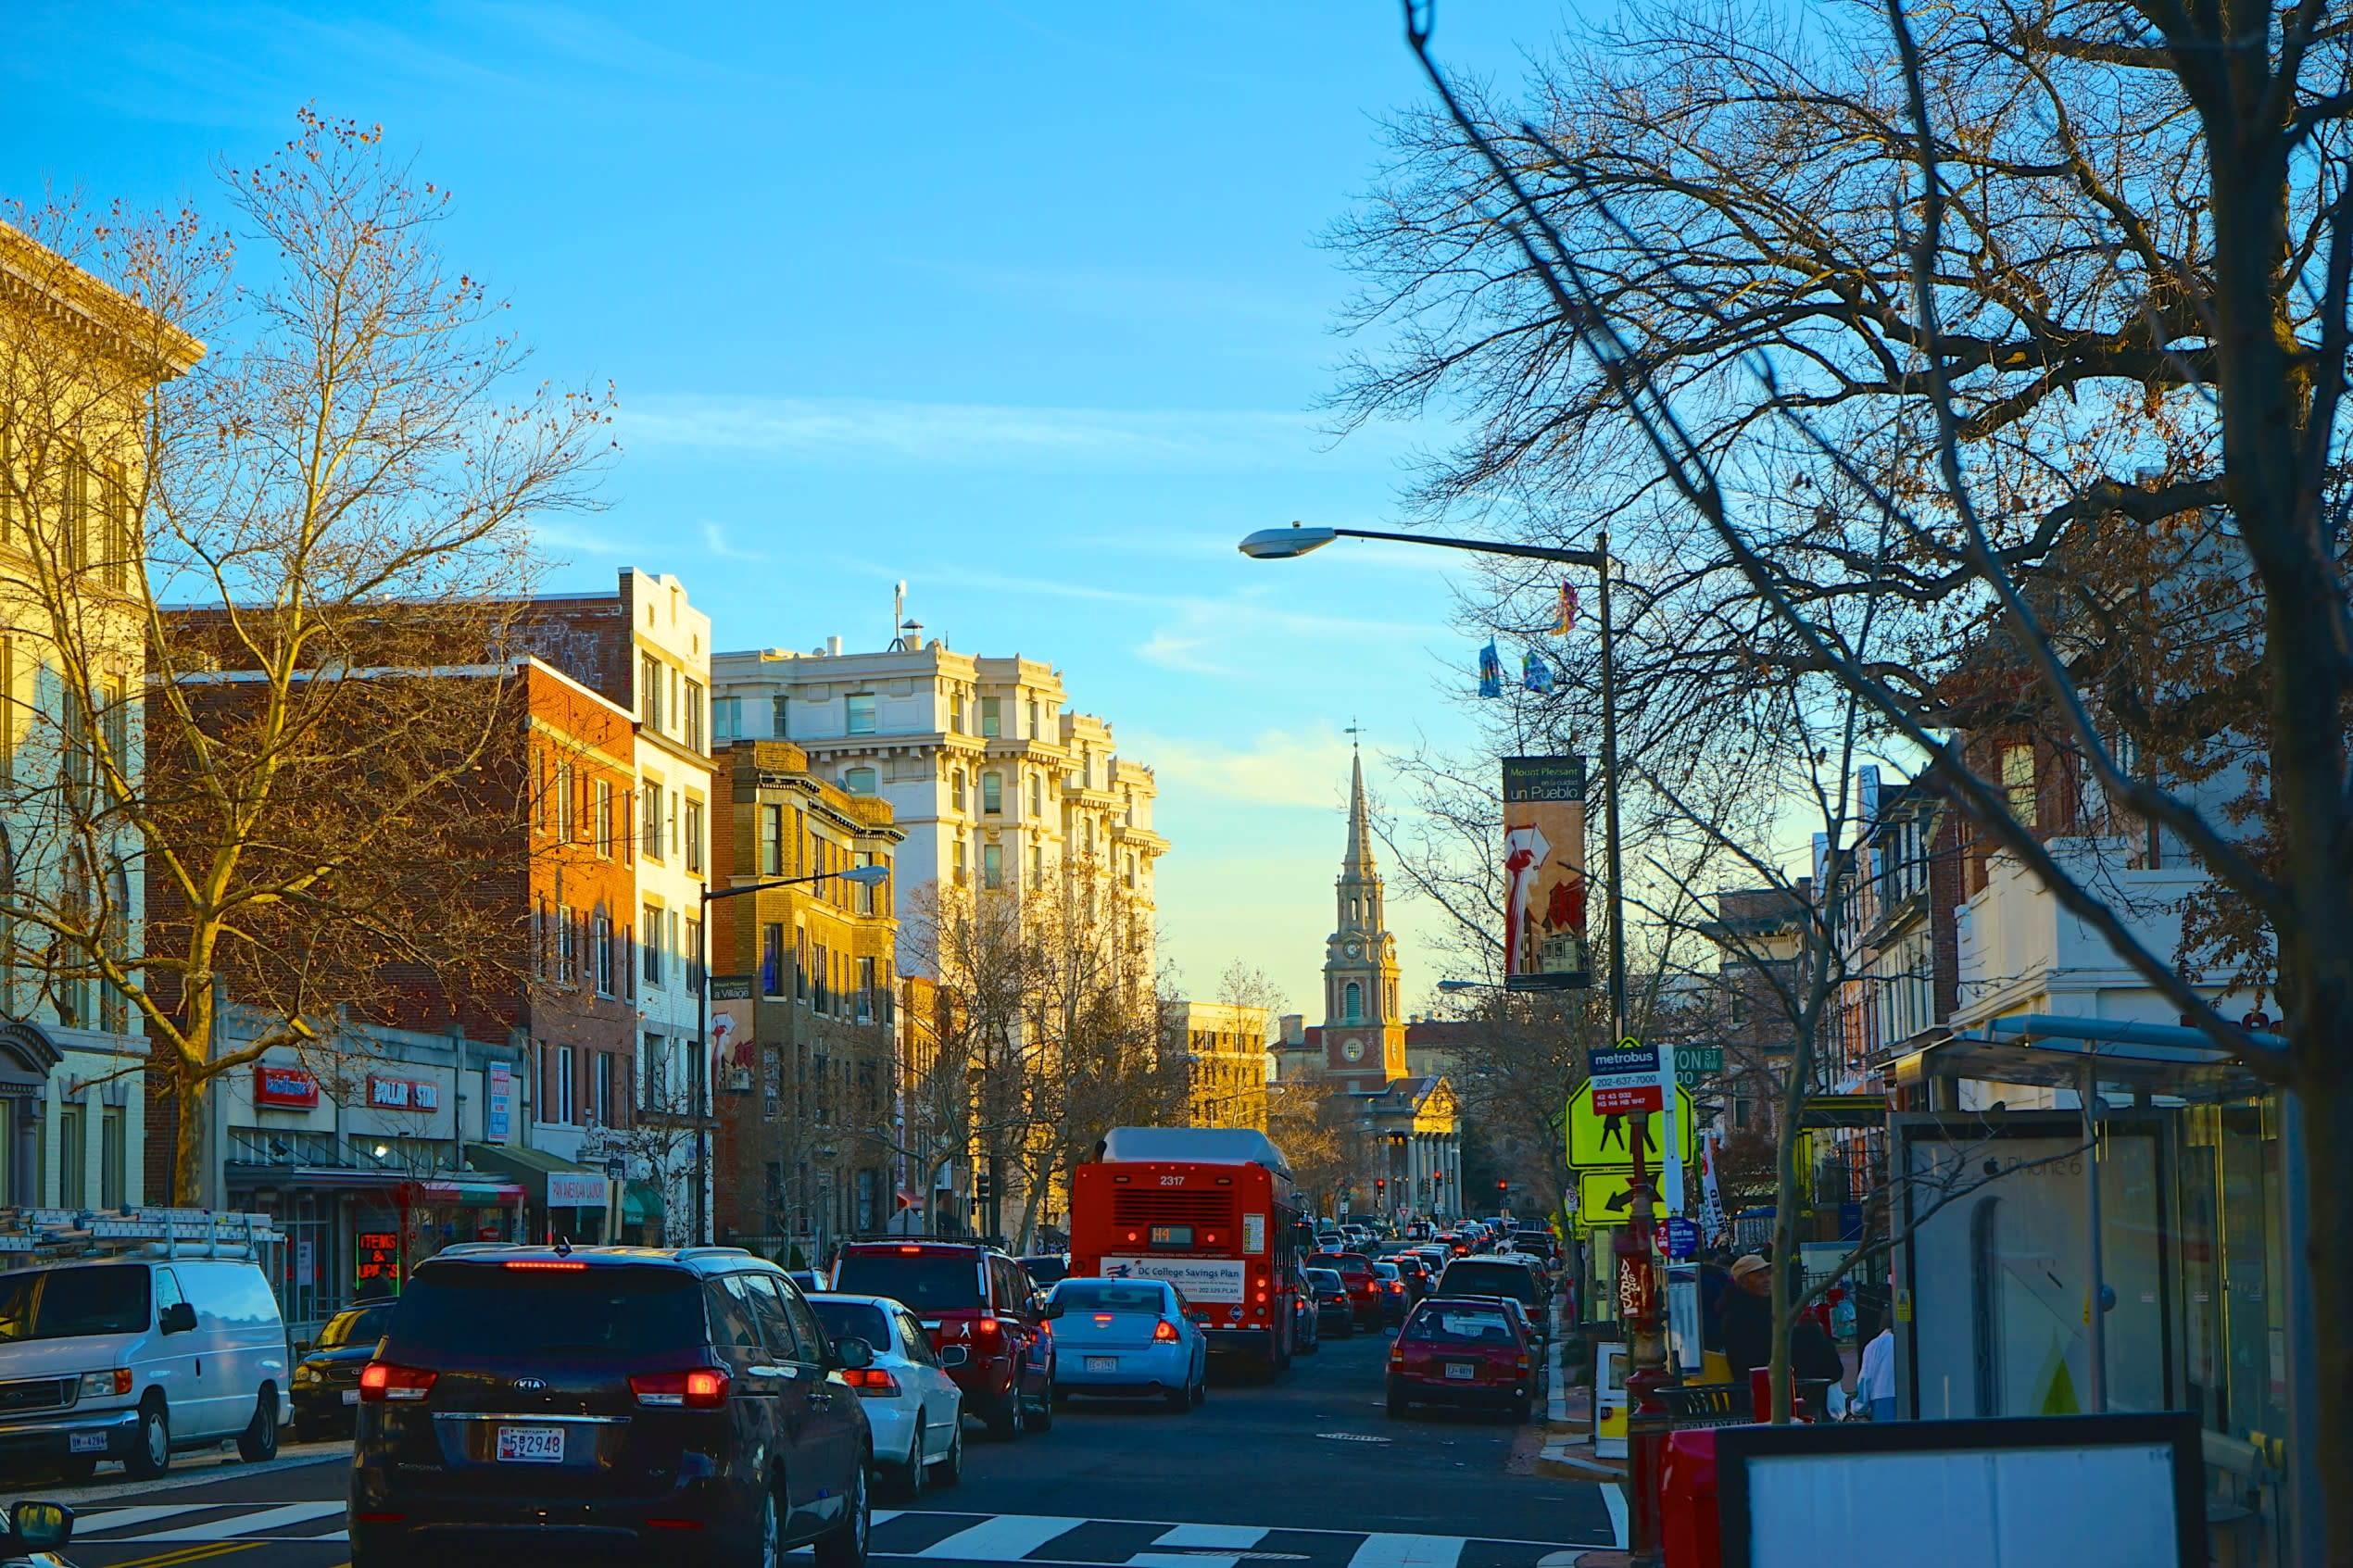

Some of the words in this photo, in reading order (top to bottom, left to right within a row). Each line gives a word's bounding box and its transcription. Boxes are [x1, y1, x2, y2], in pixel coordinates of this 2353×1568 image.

[1510, 768, 1539, 777] Mount
[1541, 767, 1579, 776] Pleasant
[1510, 788, 1528, 800] un
[1530, 785, 1579, 799] Pueblo
[721, 989, 749, 999] Village
[1595, 1051, 1654, 1065] metrobus
[1705, 1050, 1718, 1060] ST
[1705, 1060, 1718, 1070] NW
[1596, 1074, 1656, 1087] 202-637-7000
[373, 1080, 409, 1105] DOLLAR
[415, 1085, 437, 1108] STAR
[1160, 1175, 1185, 1185] 2317
[359, 1233, 397, 1249] ITEMS
[1151, 1227, 1171, 1243] H4
[372, 1249, 385, 1262] &
[1139, 1267, 1151, 1275] DC
[1152, 1267, 1184, 1277] College
[1185, 1268, 1218, 1279] Savings
[1220, 1269, 1239, 1277] Plan
[519, 1380, 541, 1388] KIA
[396, 1461, 444, 1472] SEDONA
